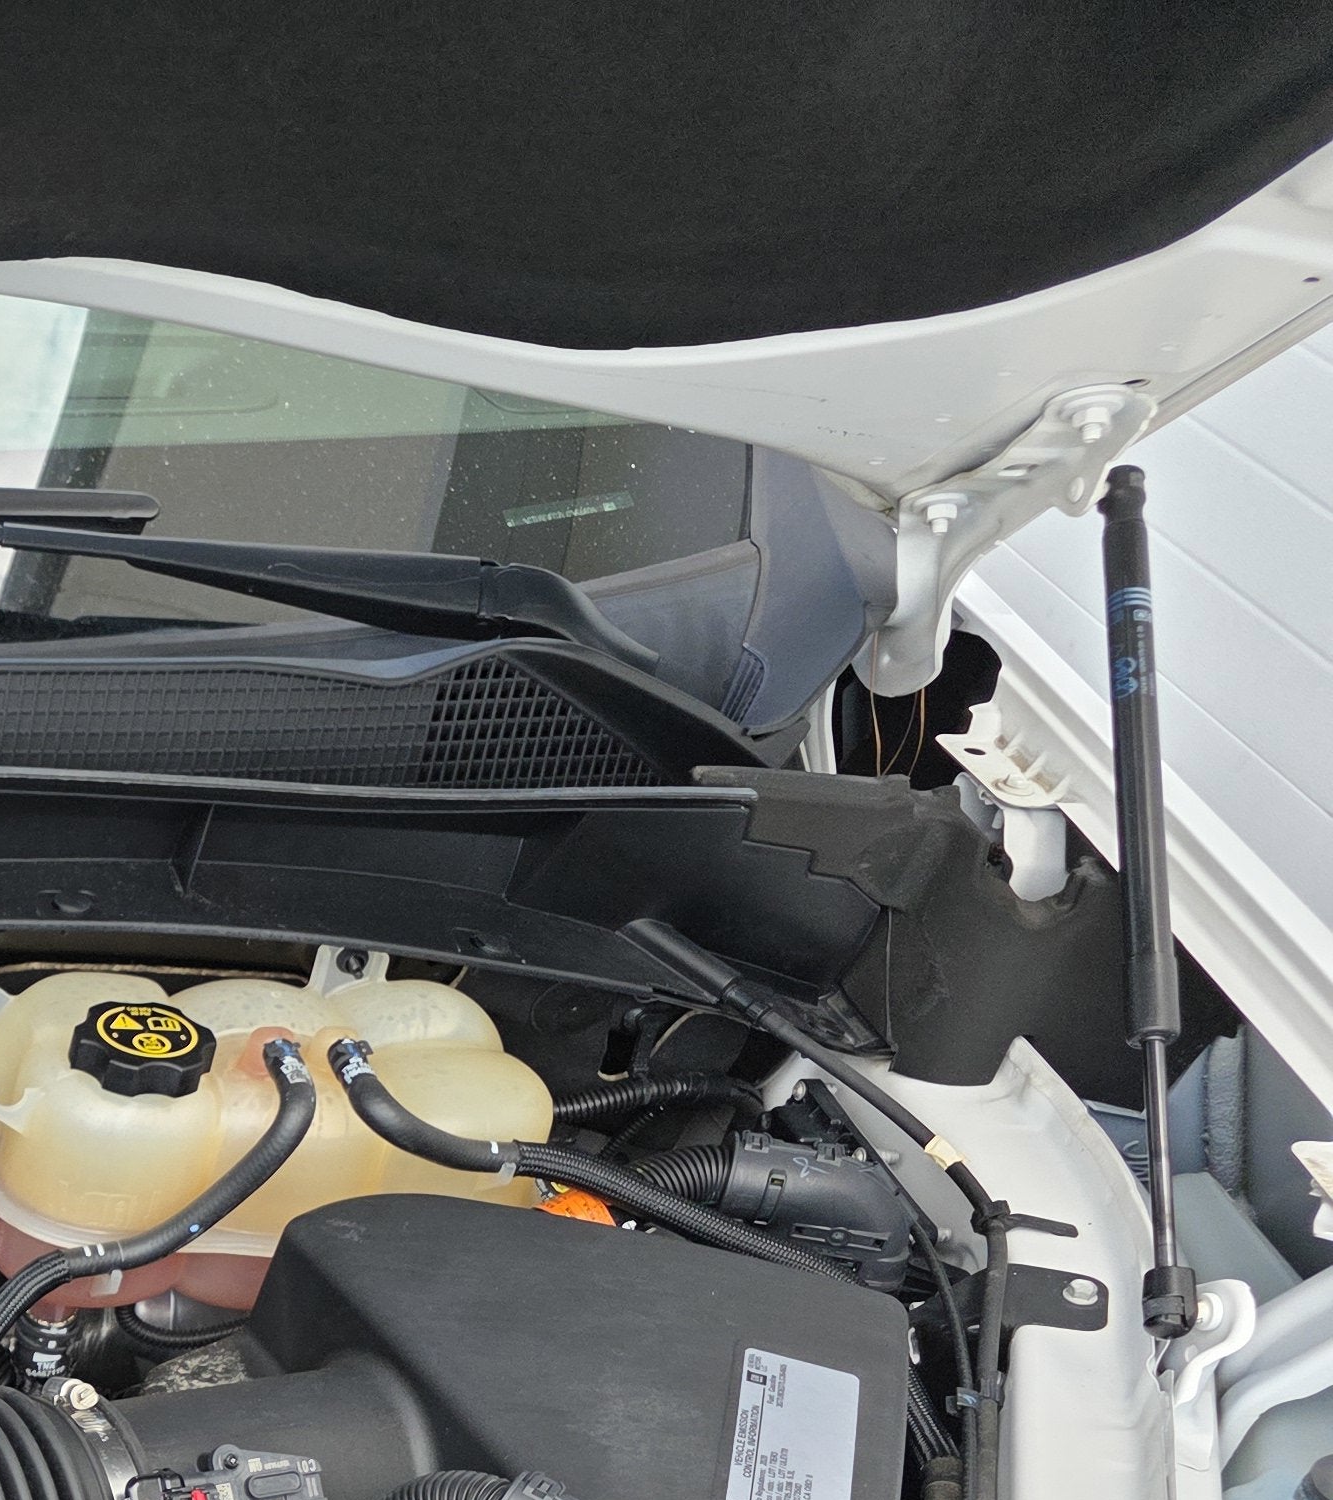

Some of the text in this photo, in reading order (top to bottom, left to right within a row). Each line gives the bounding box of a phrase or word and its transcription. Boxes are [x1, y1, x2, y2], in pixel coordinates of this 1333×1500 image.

[734, 1408, 748, 1466] VEHICLE EMISSION
[743, 1404, 759, 1477] CONTROL INFORMATION
[803, 1491, 811, 1500] CA
